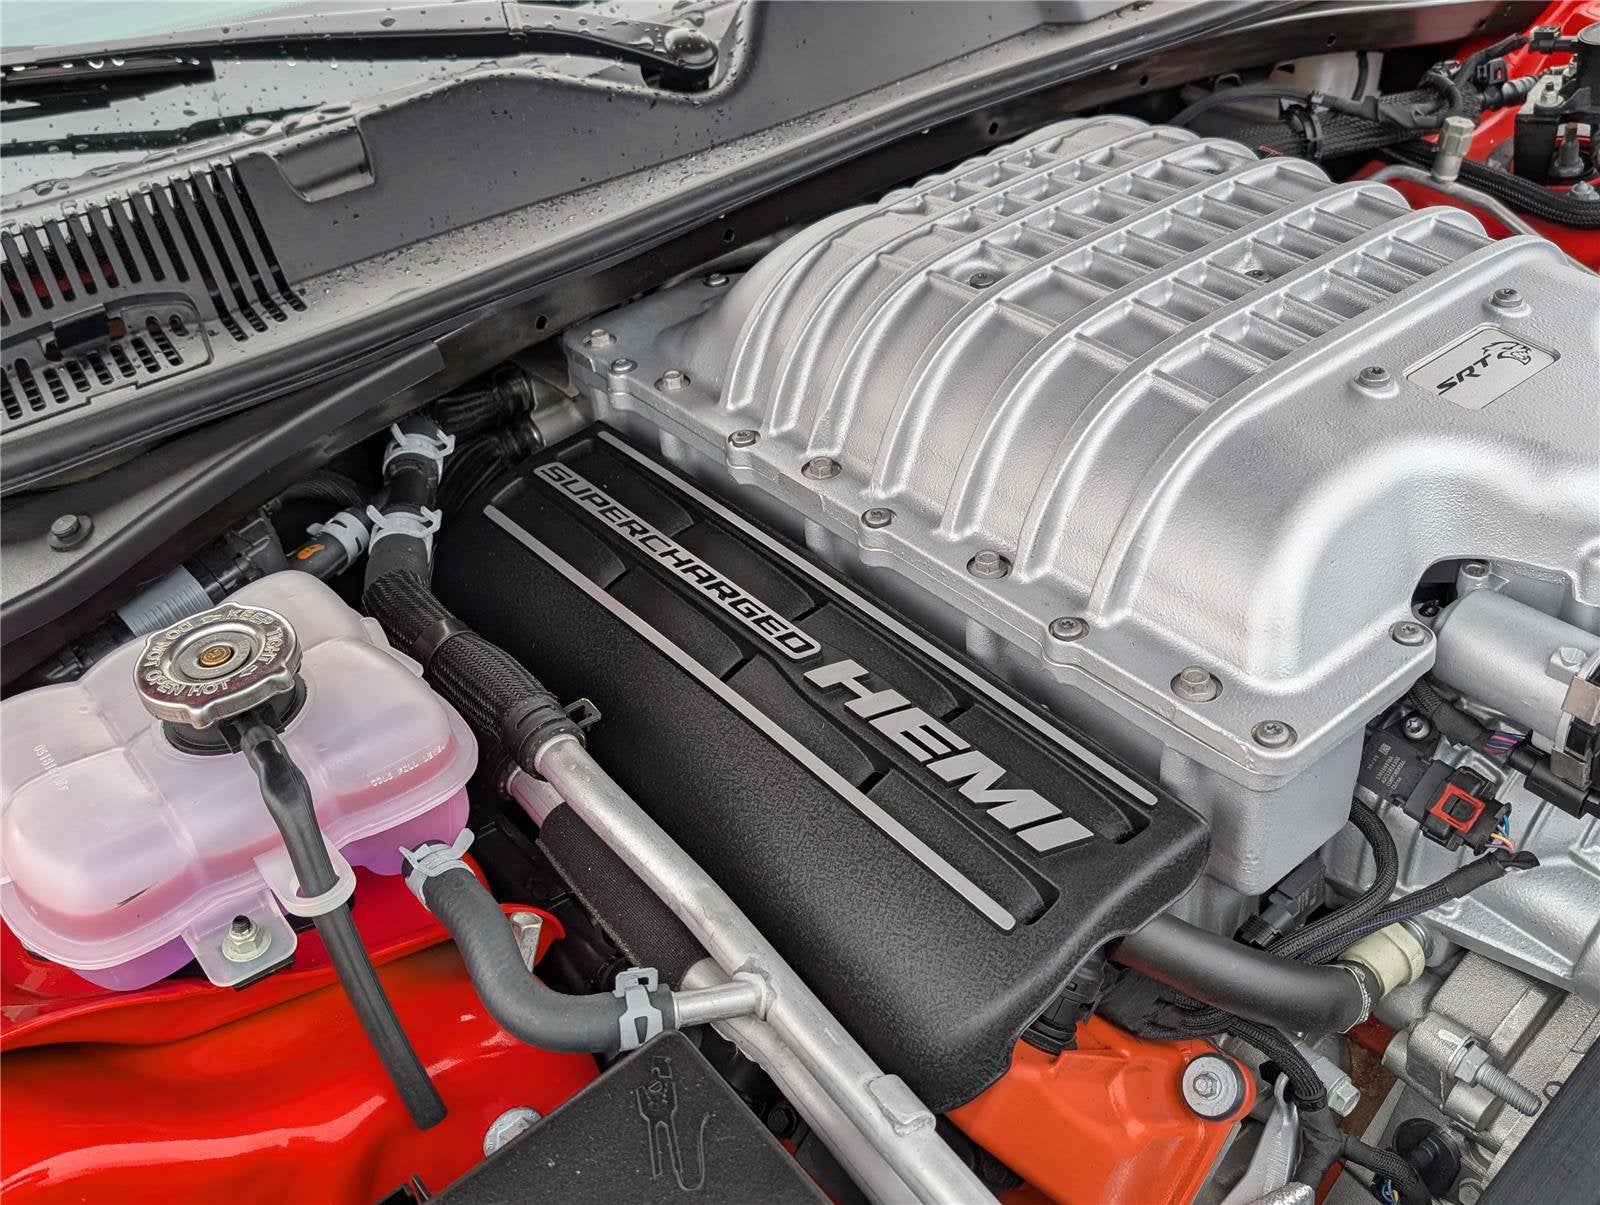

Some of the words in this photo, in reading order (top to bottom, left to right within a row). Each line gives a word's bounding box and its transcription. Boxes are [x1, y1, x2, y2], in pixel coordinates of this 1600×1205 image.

[1436, 353, 1492, 396] SRT
[540, 463, 816, 654] SUPERCHARGED
[165, 620, 193, 640] DO
[226, 609, 274, 625] KEEP
[257, 626, 284, 664] TIGHT
[144, 641, 169, 668] NOT
[145, 669, 185, 696] OPEN
[188, 680, 230, 697] HOT
[803, 658, 1094, 852] HEMI
